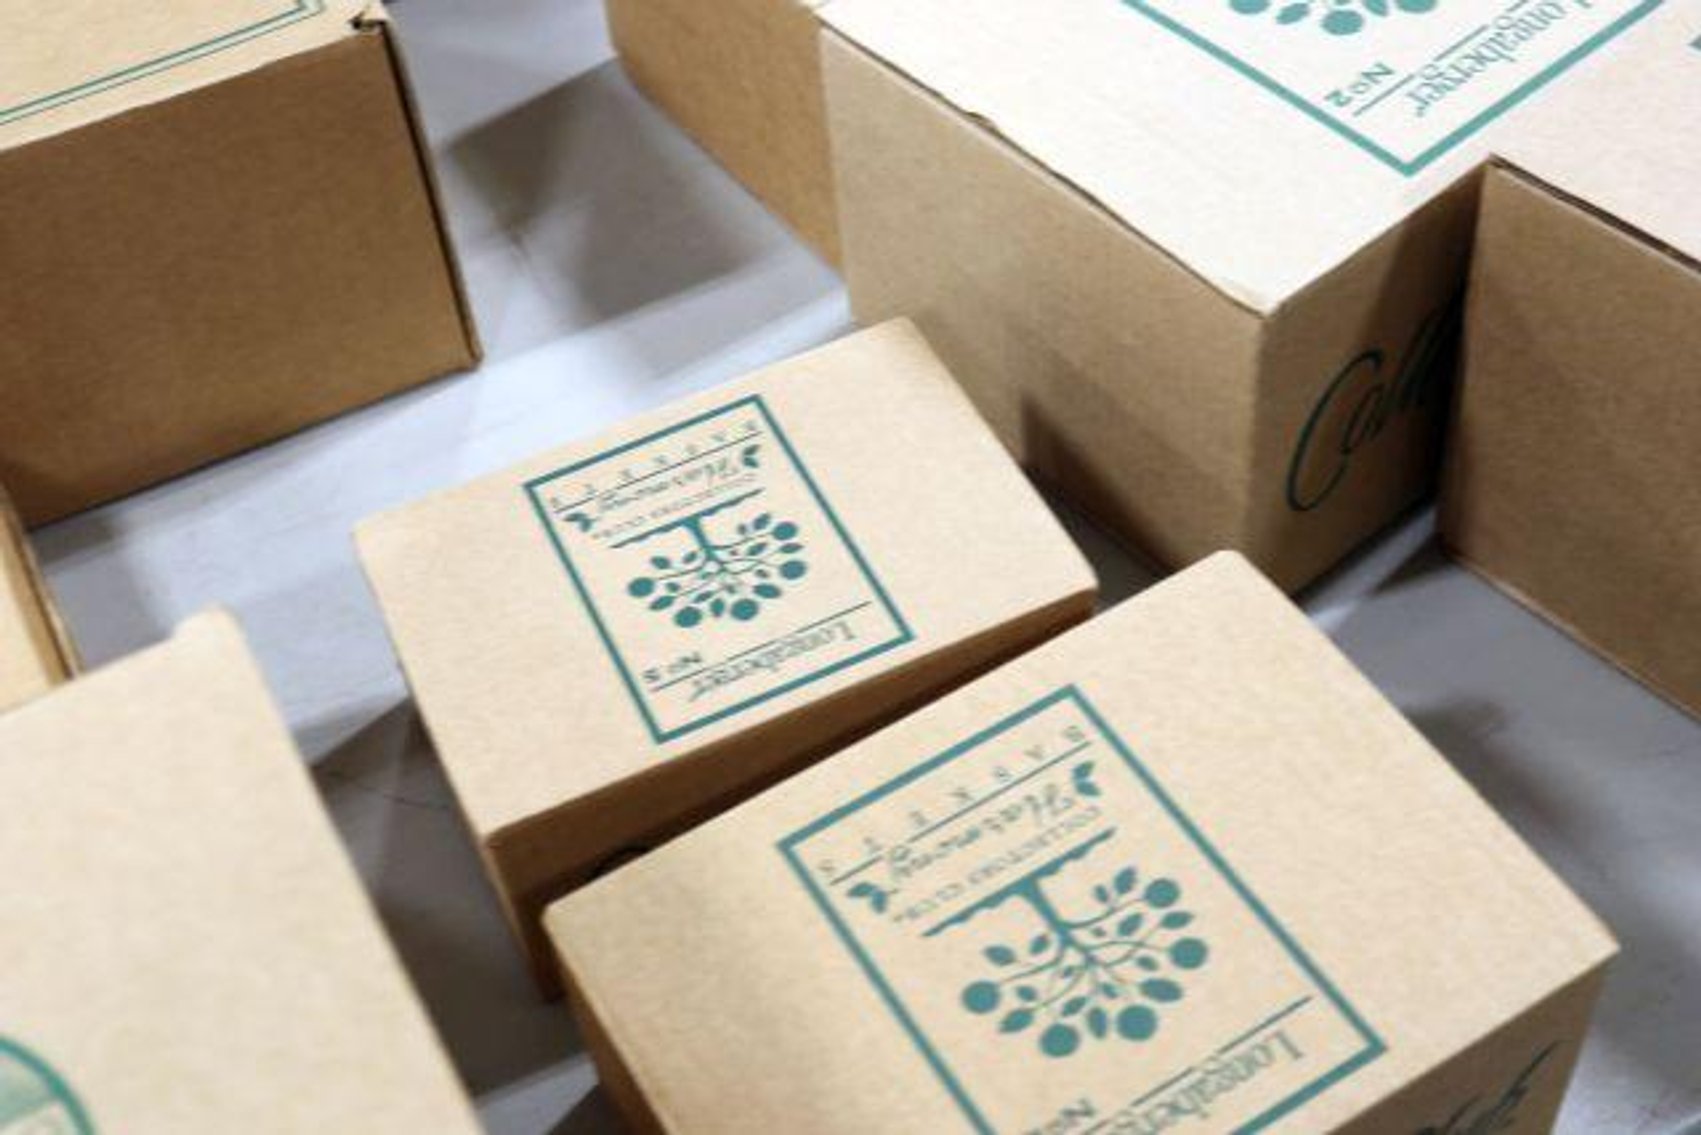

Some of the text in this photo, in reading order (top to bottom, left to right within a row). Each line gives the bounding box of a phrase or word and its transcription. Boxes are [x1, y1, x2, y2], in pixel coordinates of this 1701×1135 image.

[1406, 0, 1592, 116] ongaberger
[820, 725, 1084, 874] BASKETS
[889, 783, 1074, 879] Harmony
[1108, 1030, 1303, 1135] Longaberg
